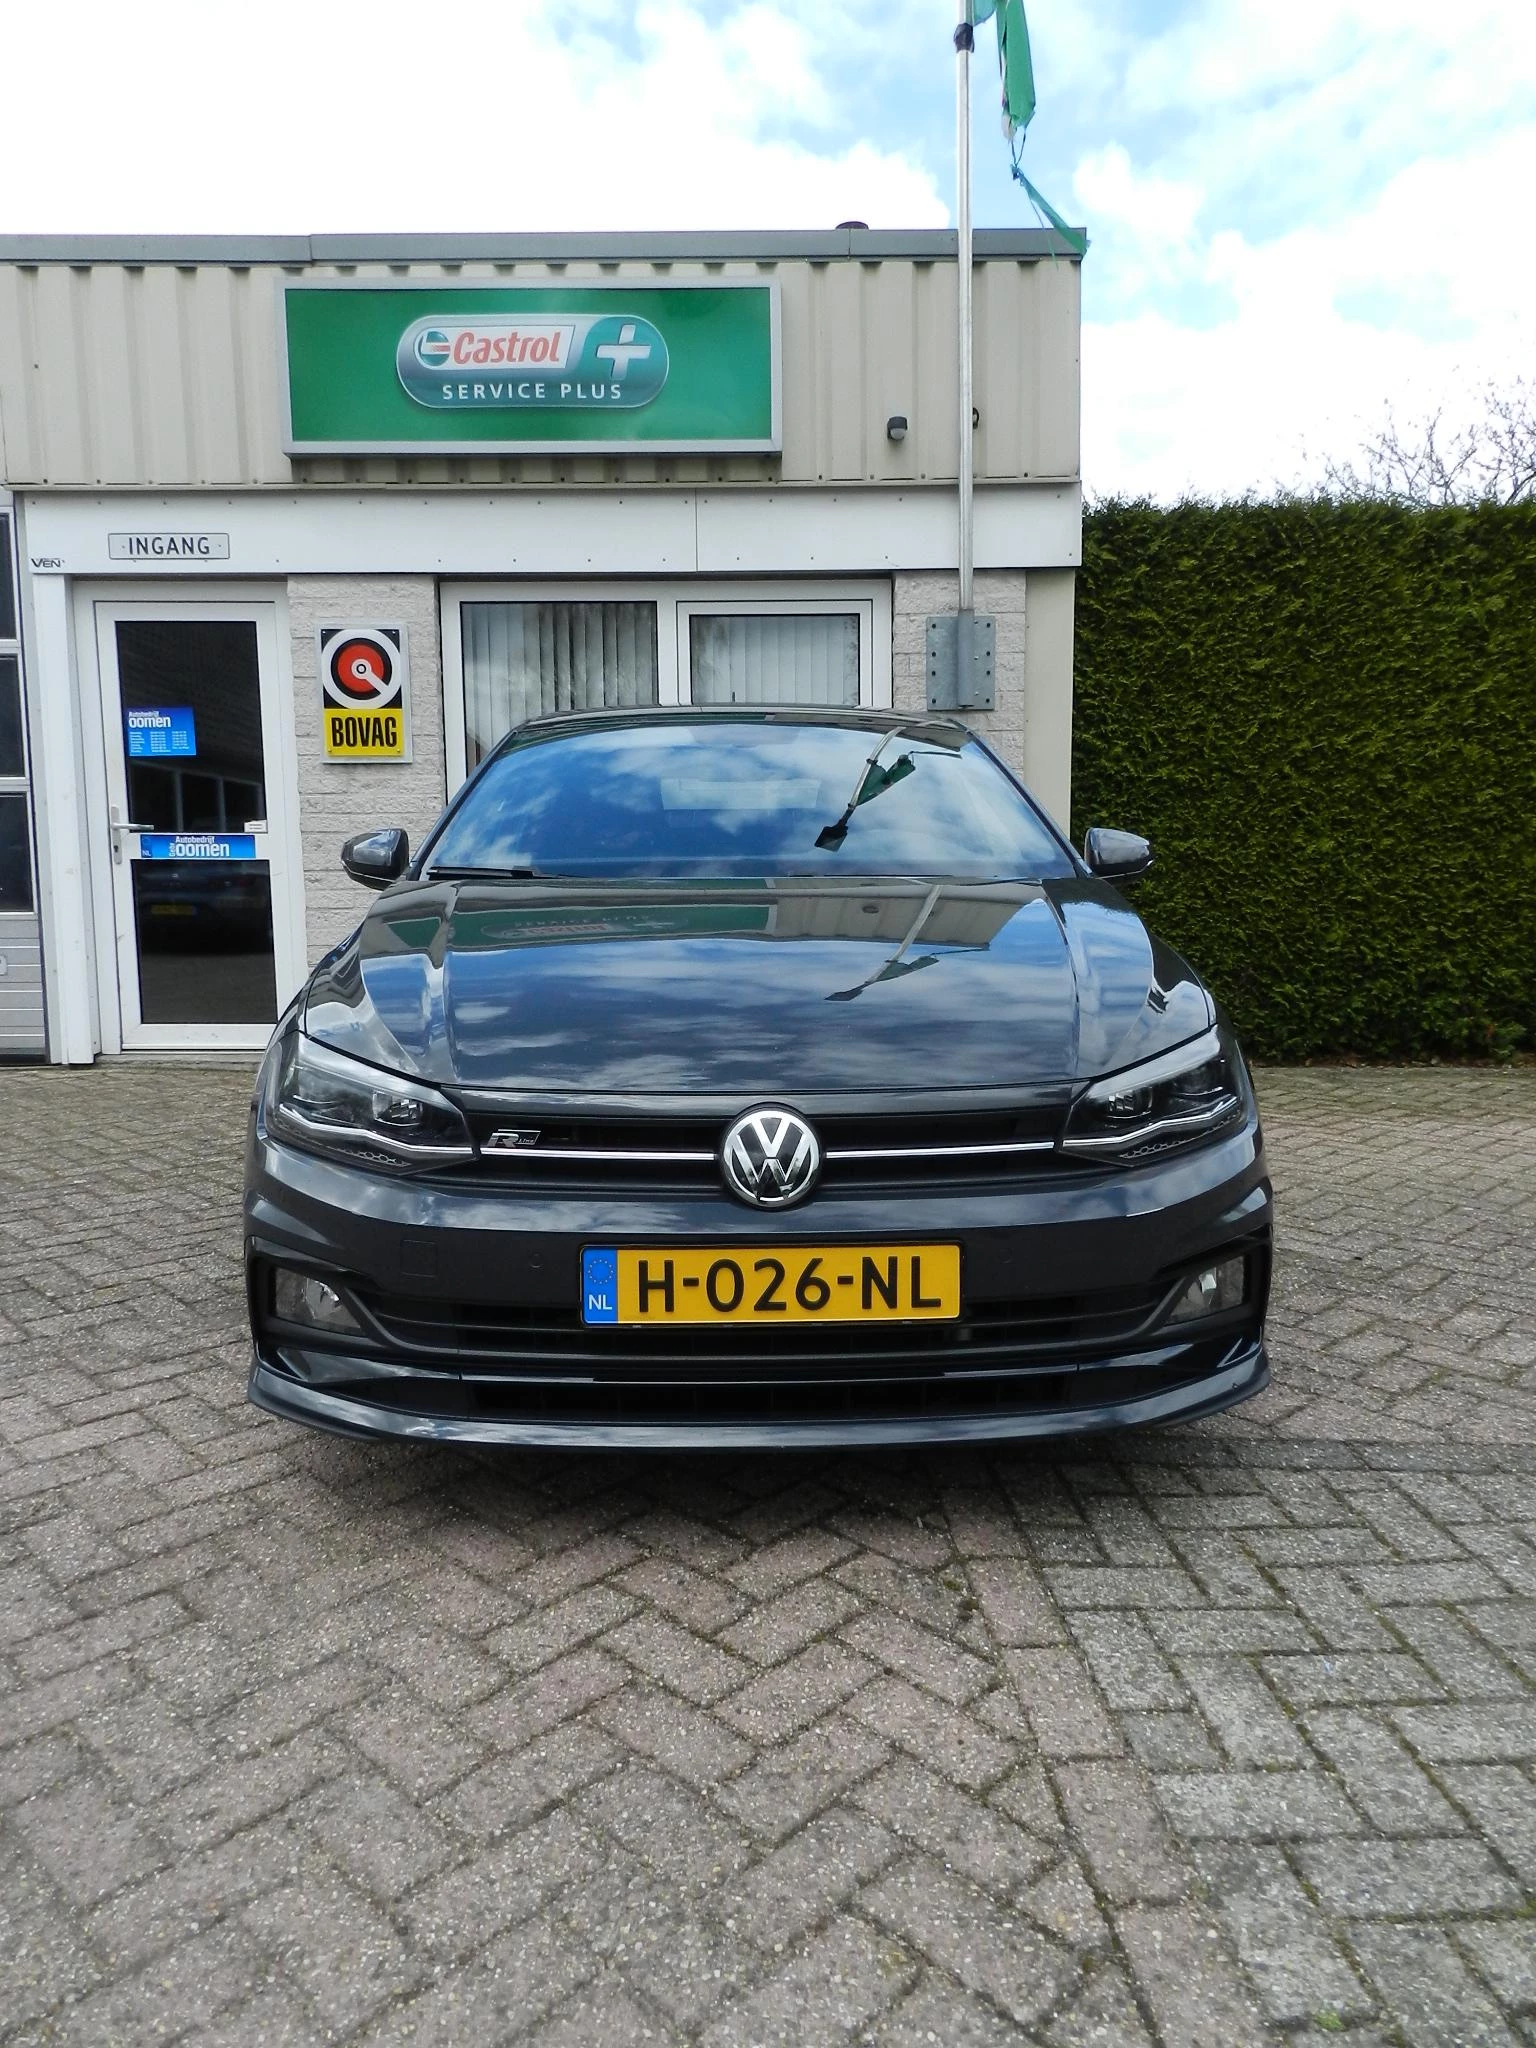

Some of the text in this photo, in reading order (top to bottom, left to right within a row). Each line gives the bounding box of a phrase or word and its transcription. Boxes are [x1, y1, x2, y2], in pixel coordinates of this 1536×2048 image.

[453, 331, 561, 365] Castrol
[442, 383, 622, 400] SERVICE PLUS
[128, 536, 211, 555] INGANG
[331, 716, 398, 748] BOVAG
[175, 835, 215, 844] Autobedrijf
[175, 843, 230, 857] oomen
[637, 1256, 943, 1313] H-026-NL
[588, 1293, 613, 1311] NL
